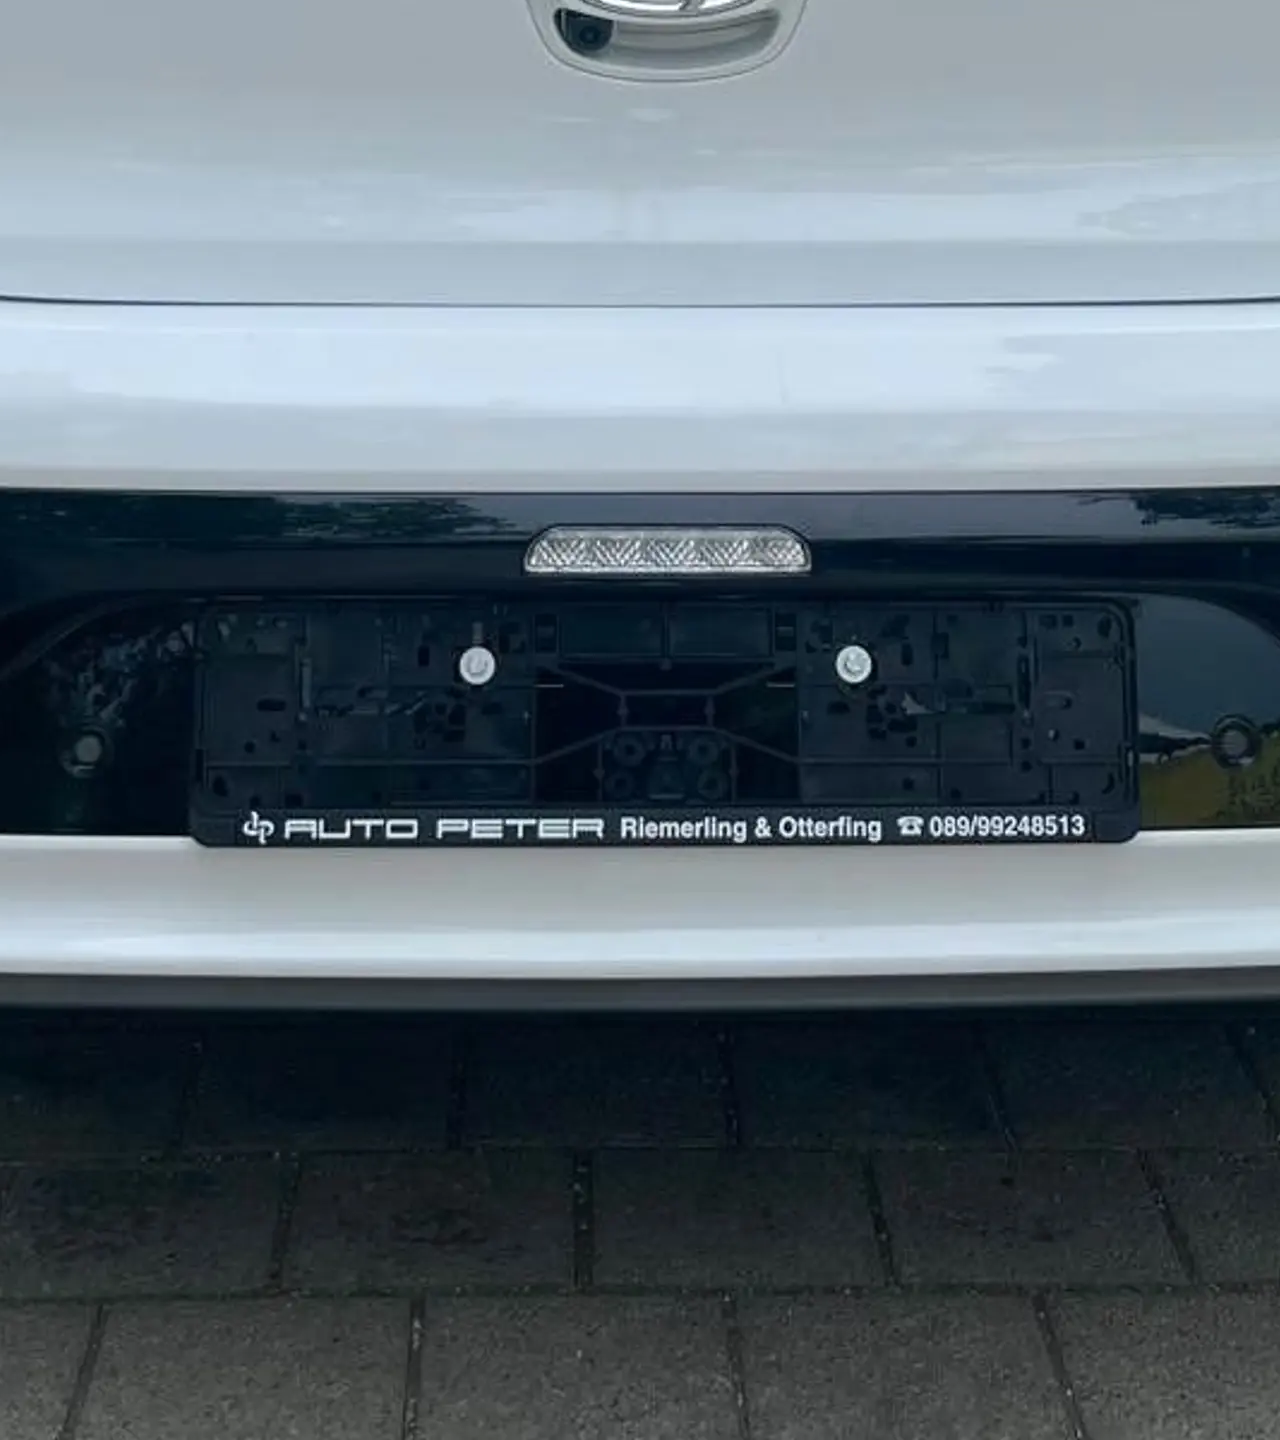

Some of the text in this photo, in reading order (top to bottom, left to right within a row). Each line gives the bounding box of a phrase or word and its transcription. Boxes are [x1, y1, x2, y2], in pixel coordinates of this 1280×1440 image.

[284, 818, 419, 840] AUTO
[435, 818, 605, 840] PETER
[620, 816, 748, 844] Riemerling
[754, 816, 773, 839] &
[778, 815, 882, 843] Otterfing
[929, 814, 1085, 837] 089/99248513
